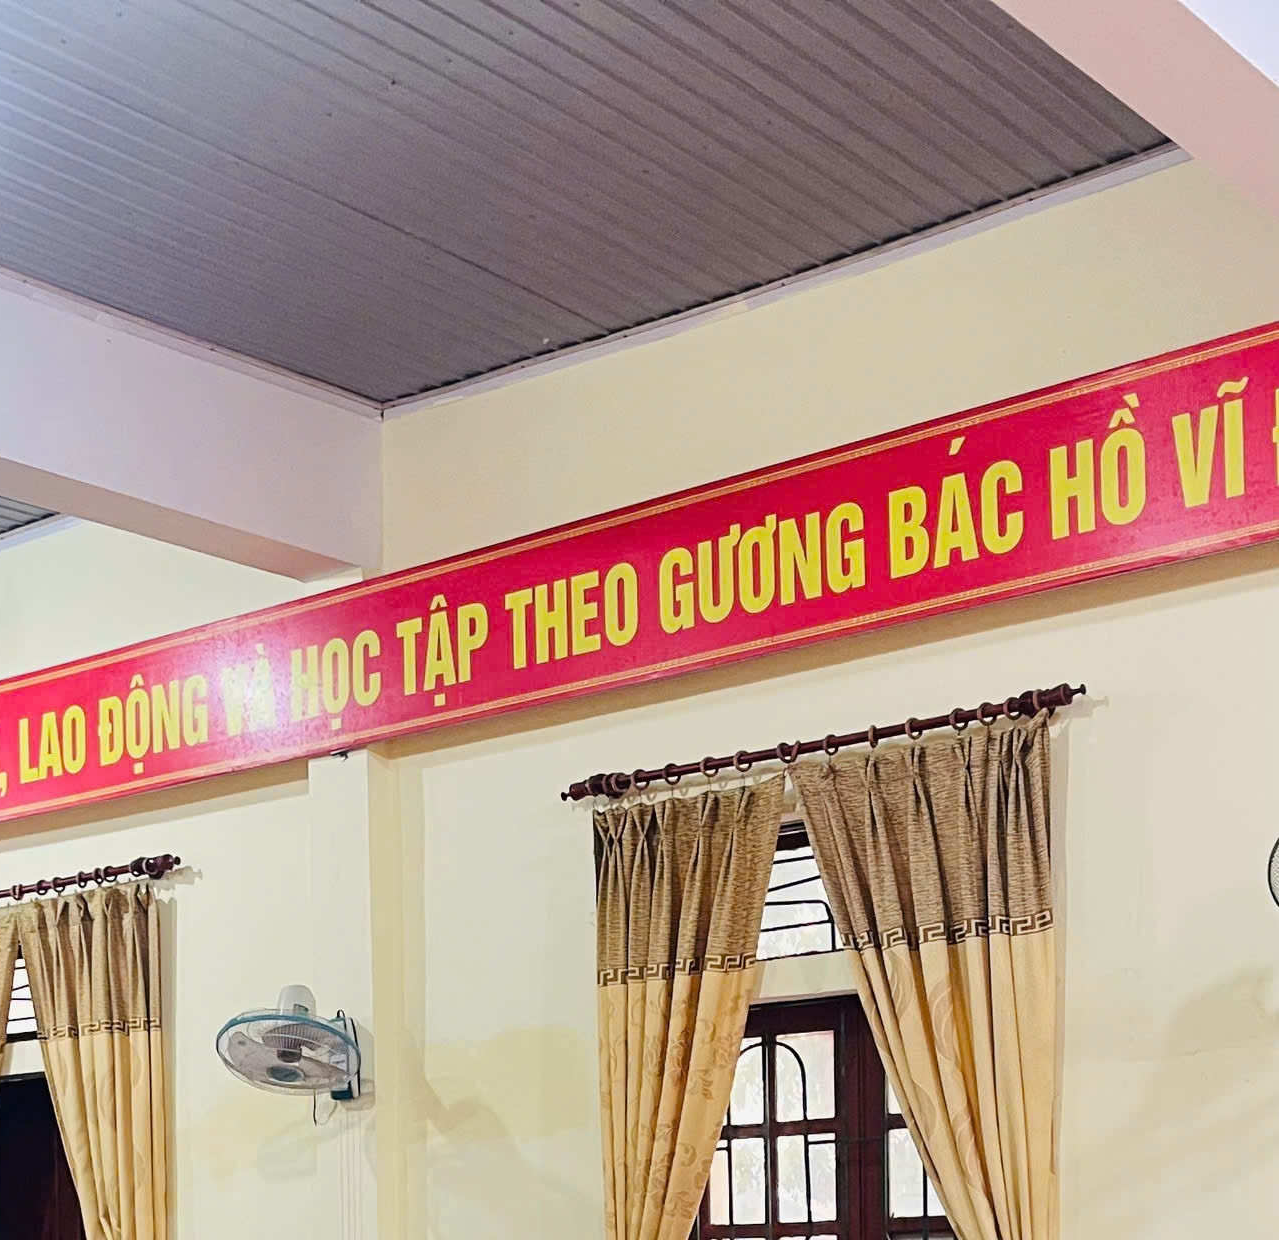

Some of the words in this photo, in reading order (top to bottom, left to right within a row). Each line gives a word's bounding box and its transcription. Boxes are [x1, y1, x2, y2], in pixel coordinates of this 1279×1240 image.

[18, 704, 86, 783] LAO
[97, 673, 209, 775] ĐỘNG
[221, 642, 277, 737] VÀ
[290, 629, 381, 731] HỌC
[396, 594, 489, 707] TẬP
[504, 561, 639, 670] THEO
[659, 502, 866, 635] GƯƠNG
[888, 437, 1025, 580] BÁC
[1049, 393, 1147, 541] HỒ
[1171, 376, 1250, 509] VĨ
